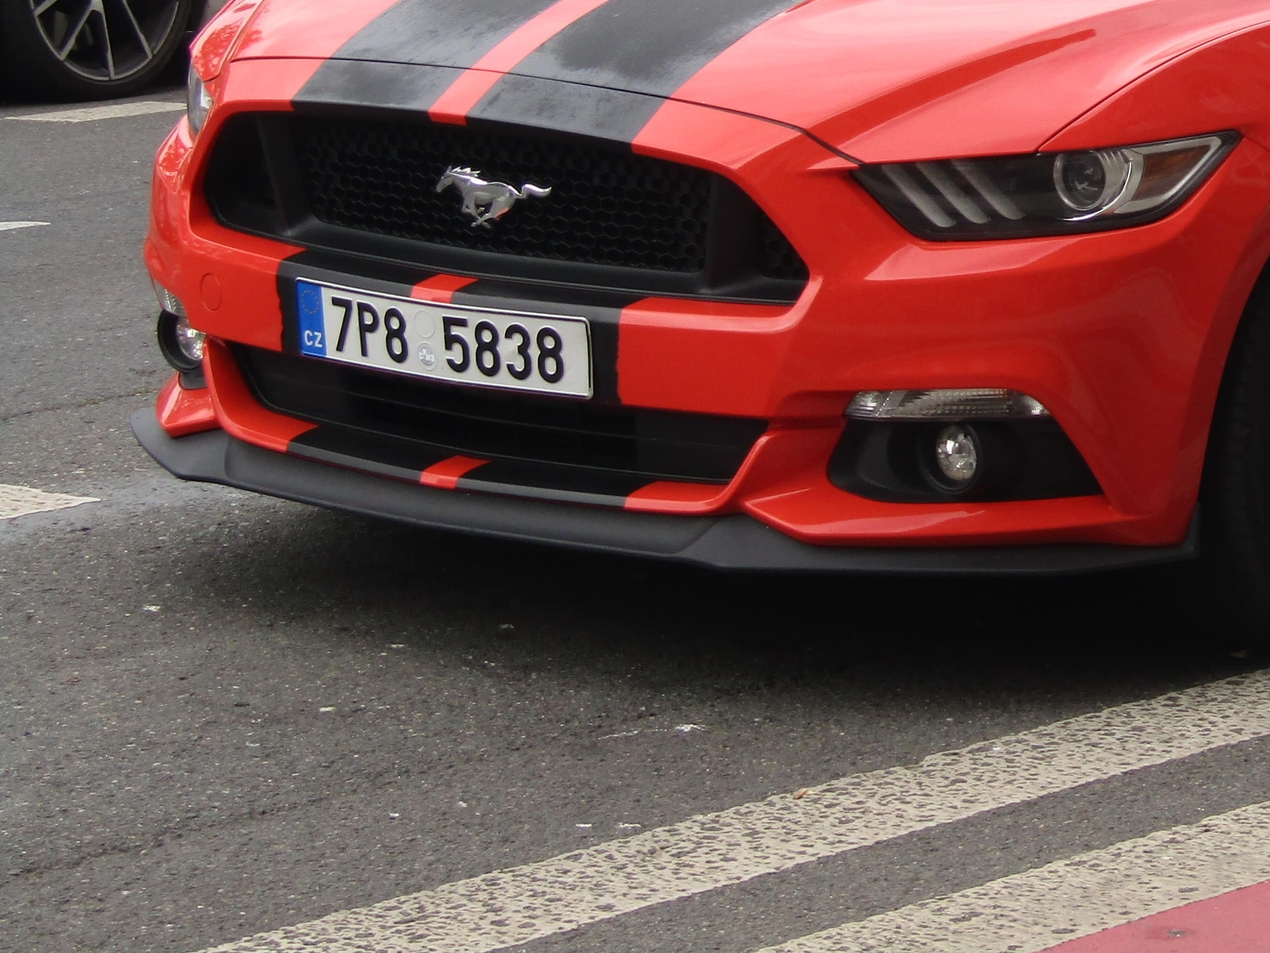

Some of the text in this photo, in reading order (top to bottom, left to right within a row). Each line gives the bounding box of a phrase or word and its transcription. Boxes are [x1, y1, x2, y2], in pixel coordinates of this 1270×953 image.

[304, 330, 323, 348] CZ
[331, 296, 565, 384] 7P8 5838
